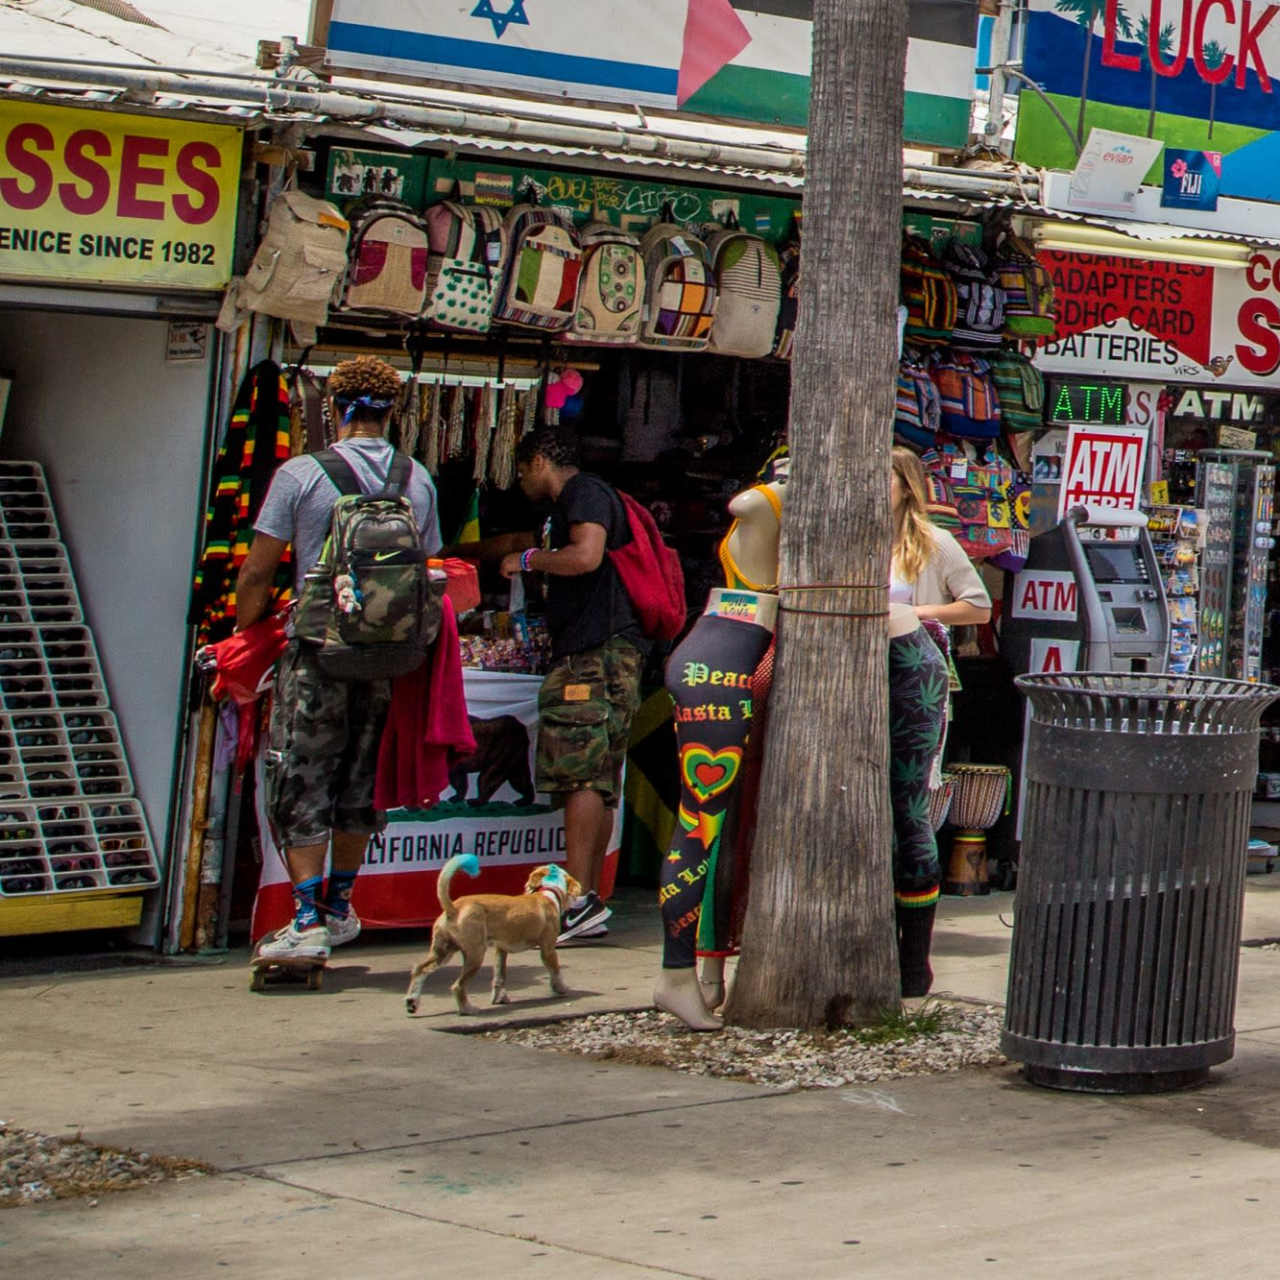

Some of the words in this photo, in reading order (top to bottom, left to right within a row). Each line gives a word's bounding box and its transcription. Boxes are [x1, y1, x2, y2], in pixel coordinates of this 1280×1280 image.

[0, 122, 222, 225] SSES
[1103, 151, 1134, 165] evian
[1181, 172, 1202, 195] FIJI
[79, 233, 155, 261] SINCE
[161, 240, 216, 266] 1982
[1052, 267, 1183, 305] ADAPTERS
[1052, 297, 1118, 329] SDHC
[1128, 307, 1196, 336] CARD
[1043, 330, 1179, 366] BATTERIES
[1053, 385, 1122, 422] ATM
[1174, 389, 1264, 421] ATM
[1067, 439, 1138, 494] ATM
[1021, 580, 1077, 613] ATM
[474, 825, 566, 857] REPUBLIC
